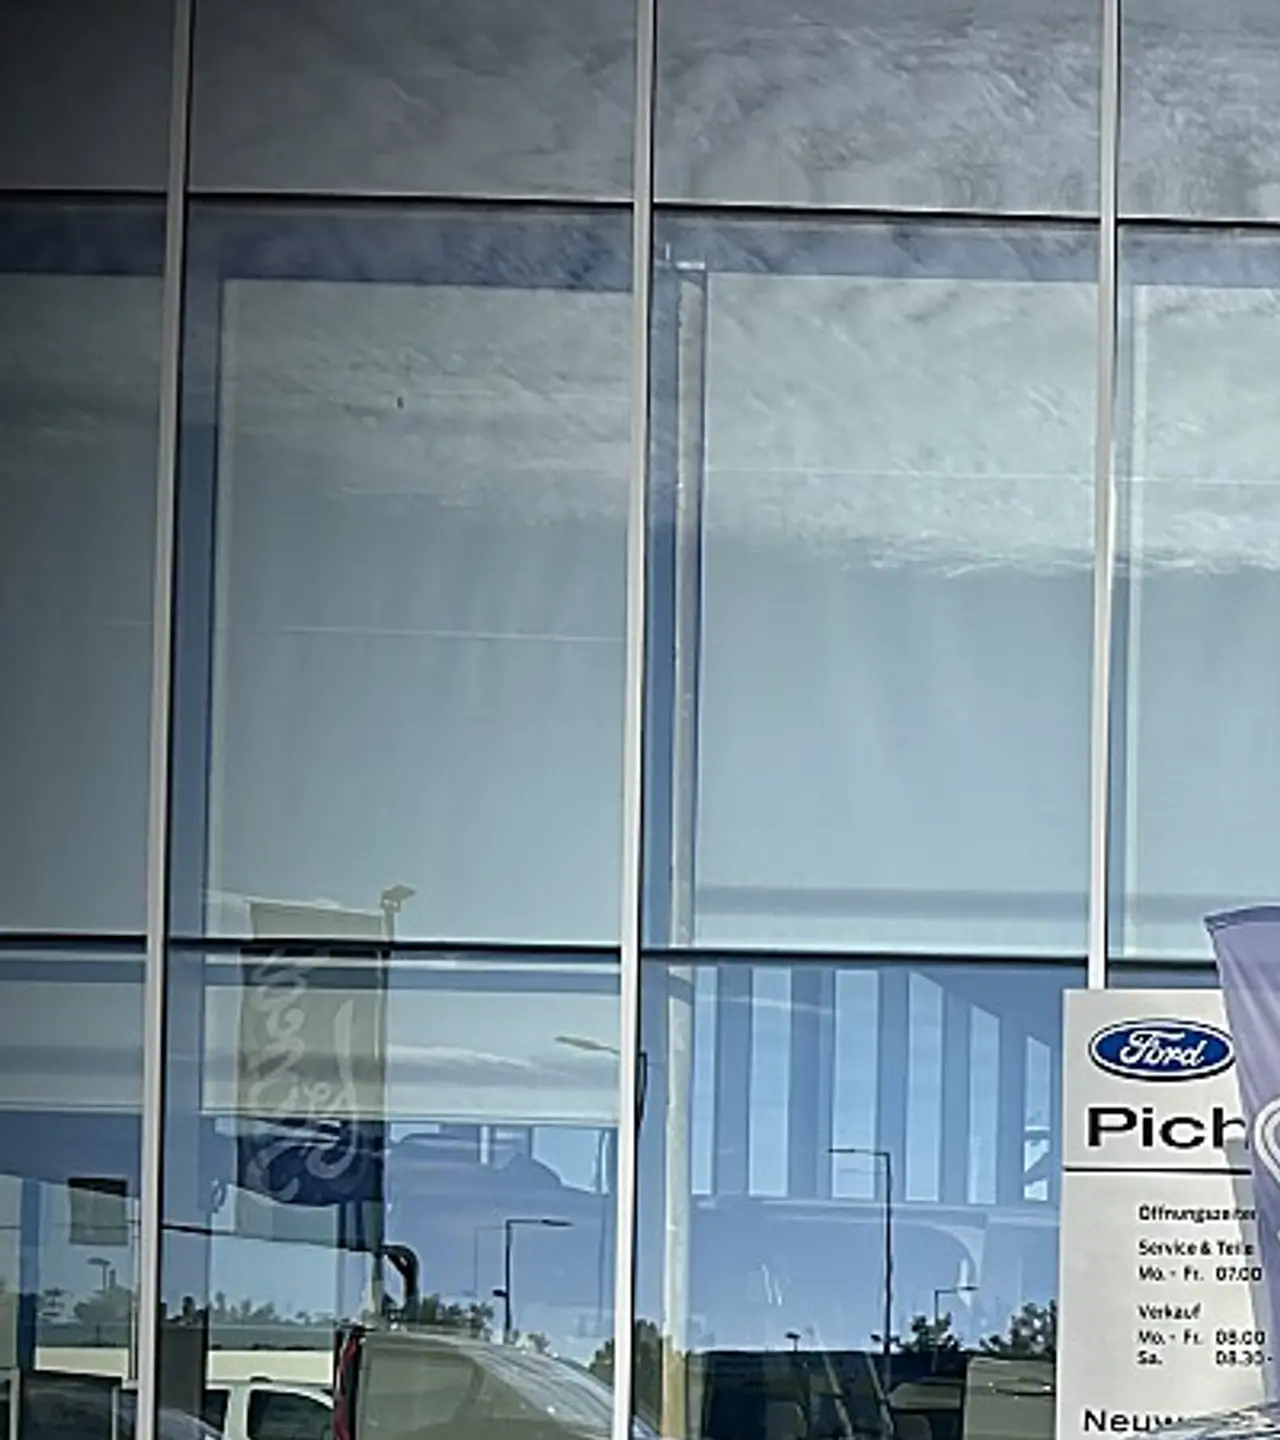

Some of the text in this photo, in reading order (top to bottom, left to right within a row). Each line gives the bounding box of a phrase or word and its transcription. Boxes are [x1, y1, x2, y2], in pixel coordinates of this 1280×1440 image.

[1119, 1030, 1208, 1067] Ford
[1138, 1240, 1255, 1256] Service & Teile
[1184, 1265, 1205, 1281] Fr.
[1215, 1266, 1263, 1281] 07.00
[1138, 1303, 1202, 1320] Verkauf
[1184, 1329, 1204, 1345] Fr.
[1137, 1350, 1163, 1365] Sa.
